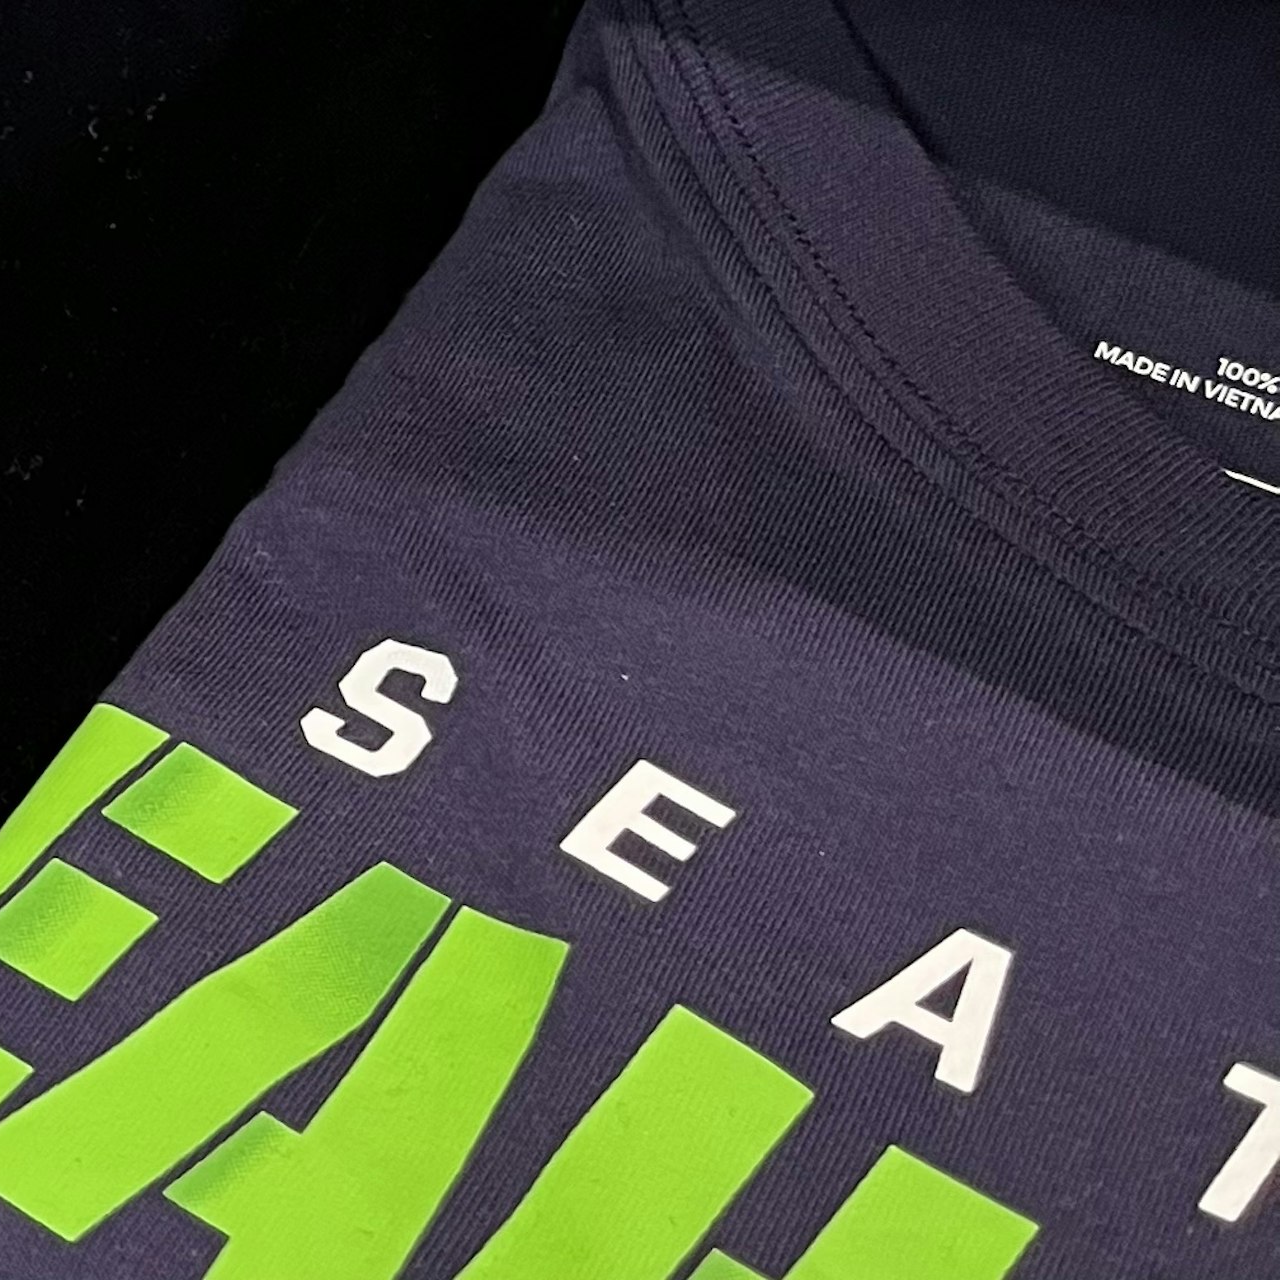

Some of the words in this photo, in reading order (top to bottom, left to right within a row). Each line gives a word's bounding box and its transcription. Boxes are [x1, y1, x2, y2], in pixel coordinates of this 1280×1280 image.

[1094, 340, 1171, 383] MADE
[1169, 368, 1200, 393] IN
[1204, 379, 1280, 421] VIETNA
[300, 638, 1280, 1223] SEAT
